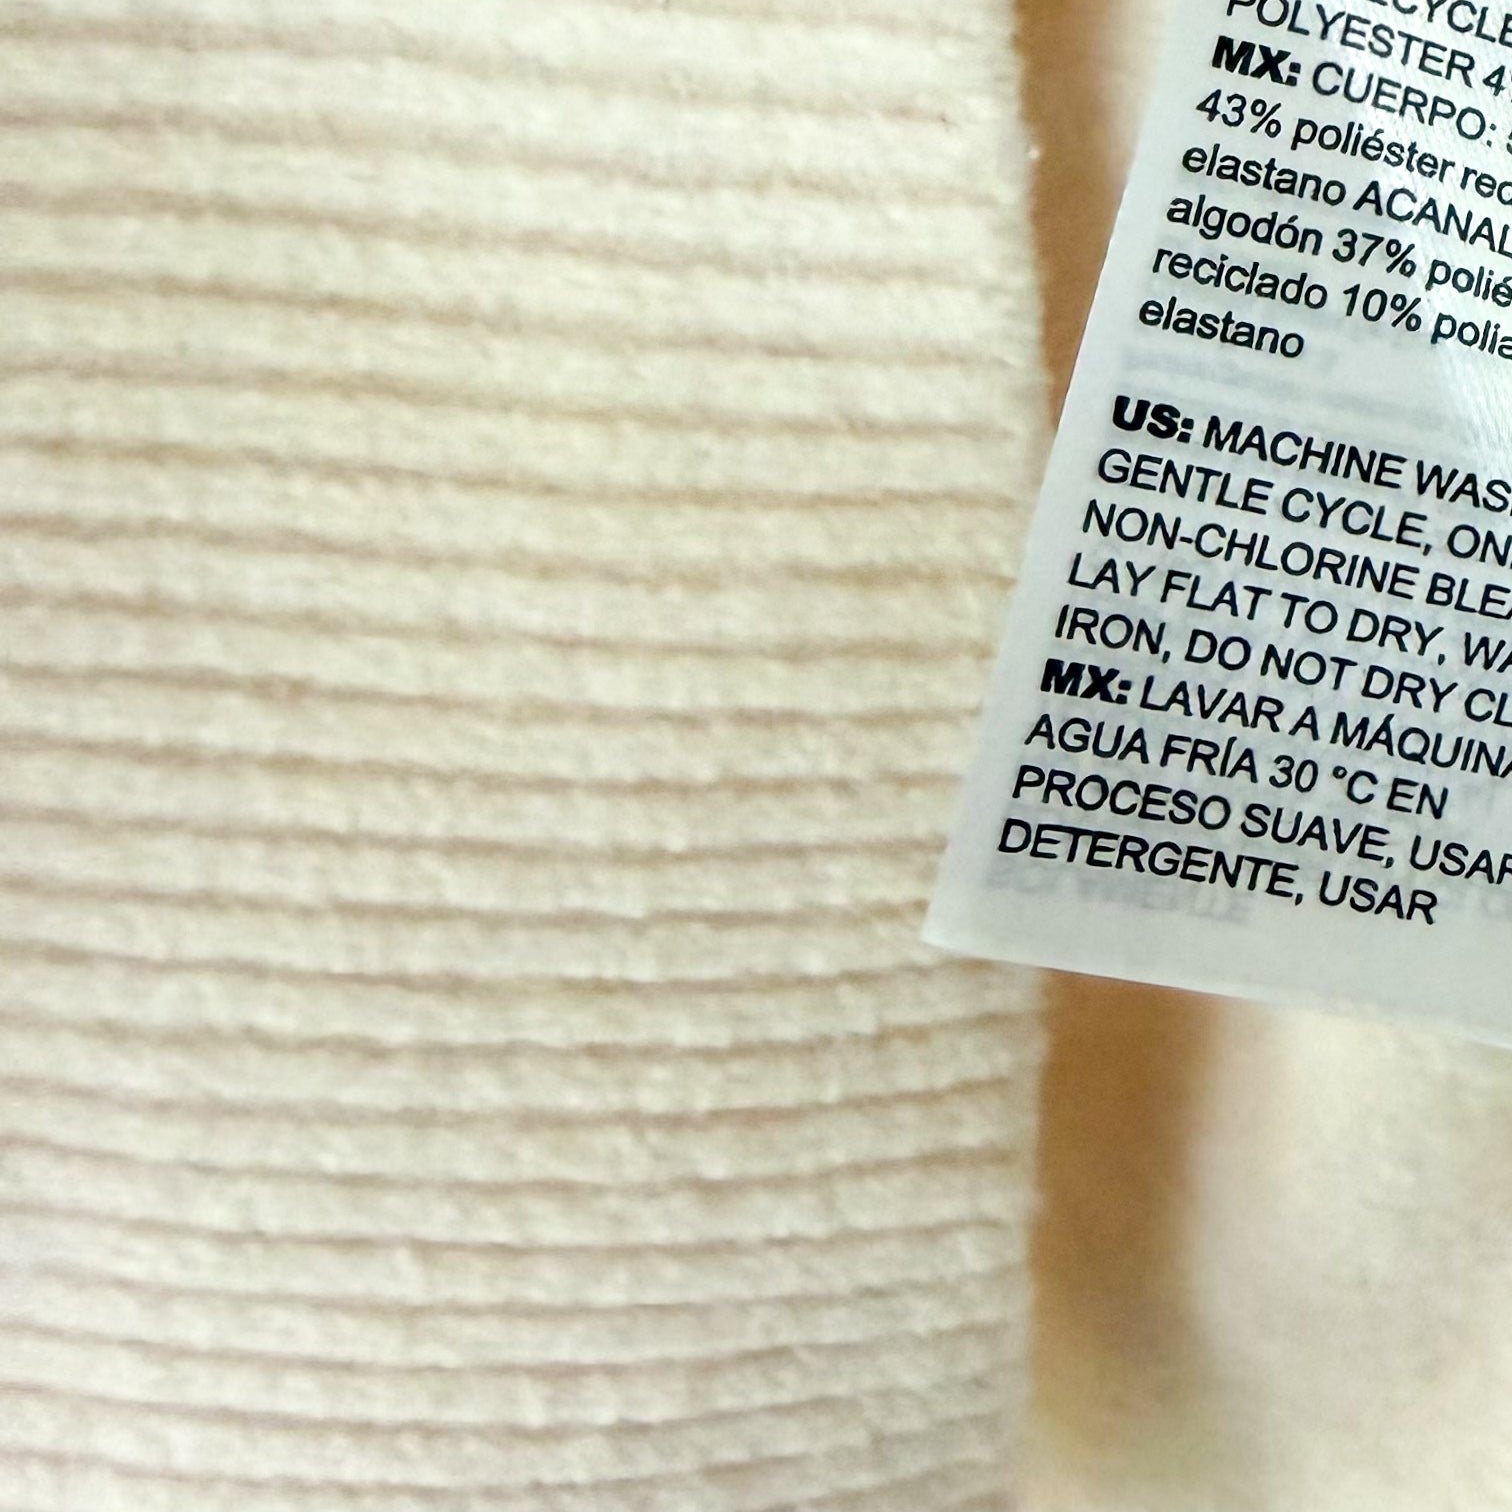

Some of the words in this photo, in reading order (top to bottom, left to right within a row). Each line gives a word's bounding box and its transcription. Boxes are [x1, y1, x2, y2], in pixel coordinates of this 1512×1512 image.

[1195, 88, 1282, 139] 43%
[1290, 117, 1456, 183] poliéster
[1211, 34, 1302, 87] MX:
[1311, 61, 1497, 148] CUERPO:
[1181, 143, 1347, 207] elastano
[1166, 194, 1324, 256] algodón
[1331, 228, 1417, 279] 37%
[1138, 295, 1305, 359] elastano
[1152, 248, 1328, 310] reciclado
[1342, 283, 1422, 332] 10%
[1112, 394, 1195, 444] US:
[1202, 415, 1408, 490] MACHINE
[1082, 498, 1420, 600] NON-CHLORINE
[1097, 448, 1275, 516] GENTLE
[1281, 487, 1433, 557] CYCLE,
[1054, 603, 1171, 665] IRON,
[1184, 628, 1252, 672] DO
[1260, 643, 1359, 691] NOT
[1360, 664, 1459, 714] DRY
[1067, 552, 1157, 597] LAY
[1159, 569, 1273, 621] FLAT
[1280, 592, 1339, 635] TO
[1345, 607, 1446, 666] DRY,
[1039, 657, 1133, 705] MX:
[1139, 674, 1285, 733] LAVAR
[1287, 705, 1320, 742] A
[1011, 764, 1232, 831] PROCESO
[1240, 802, 1395, 870] SUAVE,
[1023, 713, 1150, 765] AGUA
[1159, 733, 1259, 784] FRÍA
[1268, 754, 1319, 794] 30
[1386, 777, 1449, 820] EN
[996, 817, 1304, 907] DETERGENTE,
[1318, 870, 1438, 926] USAR
